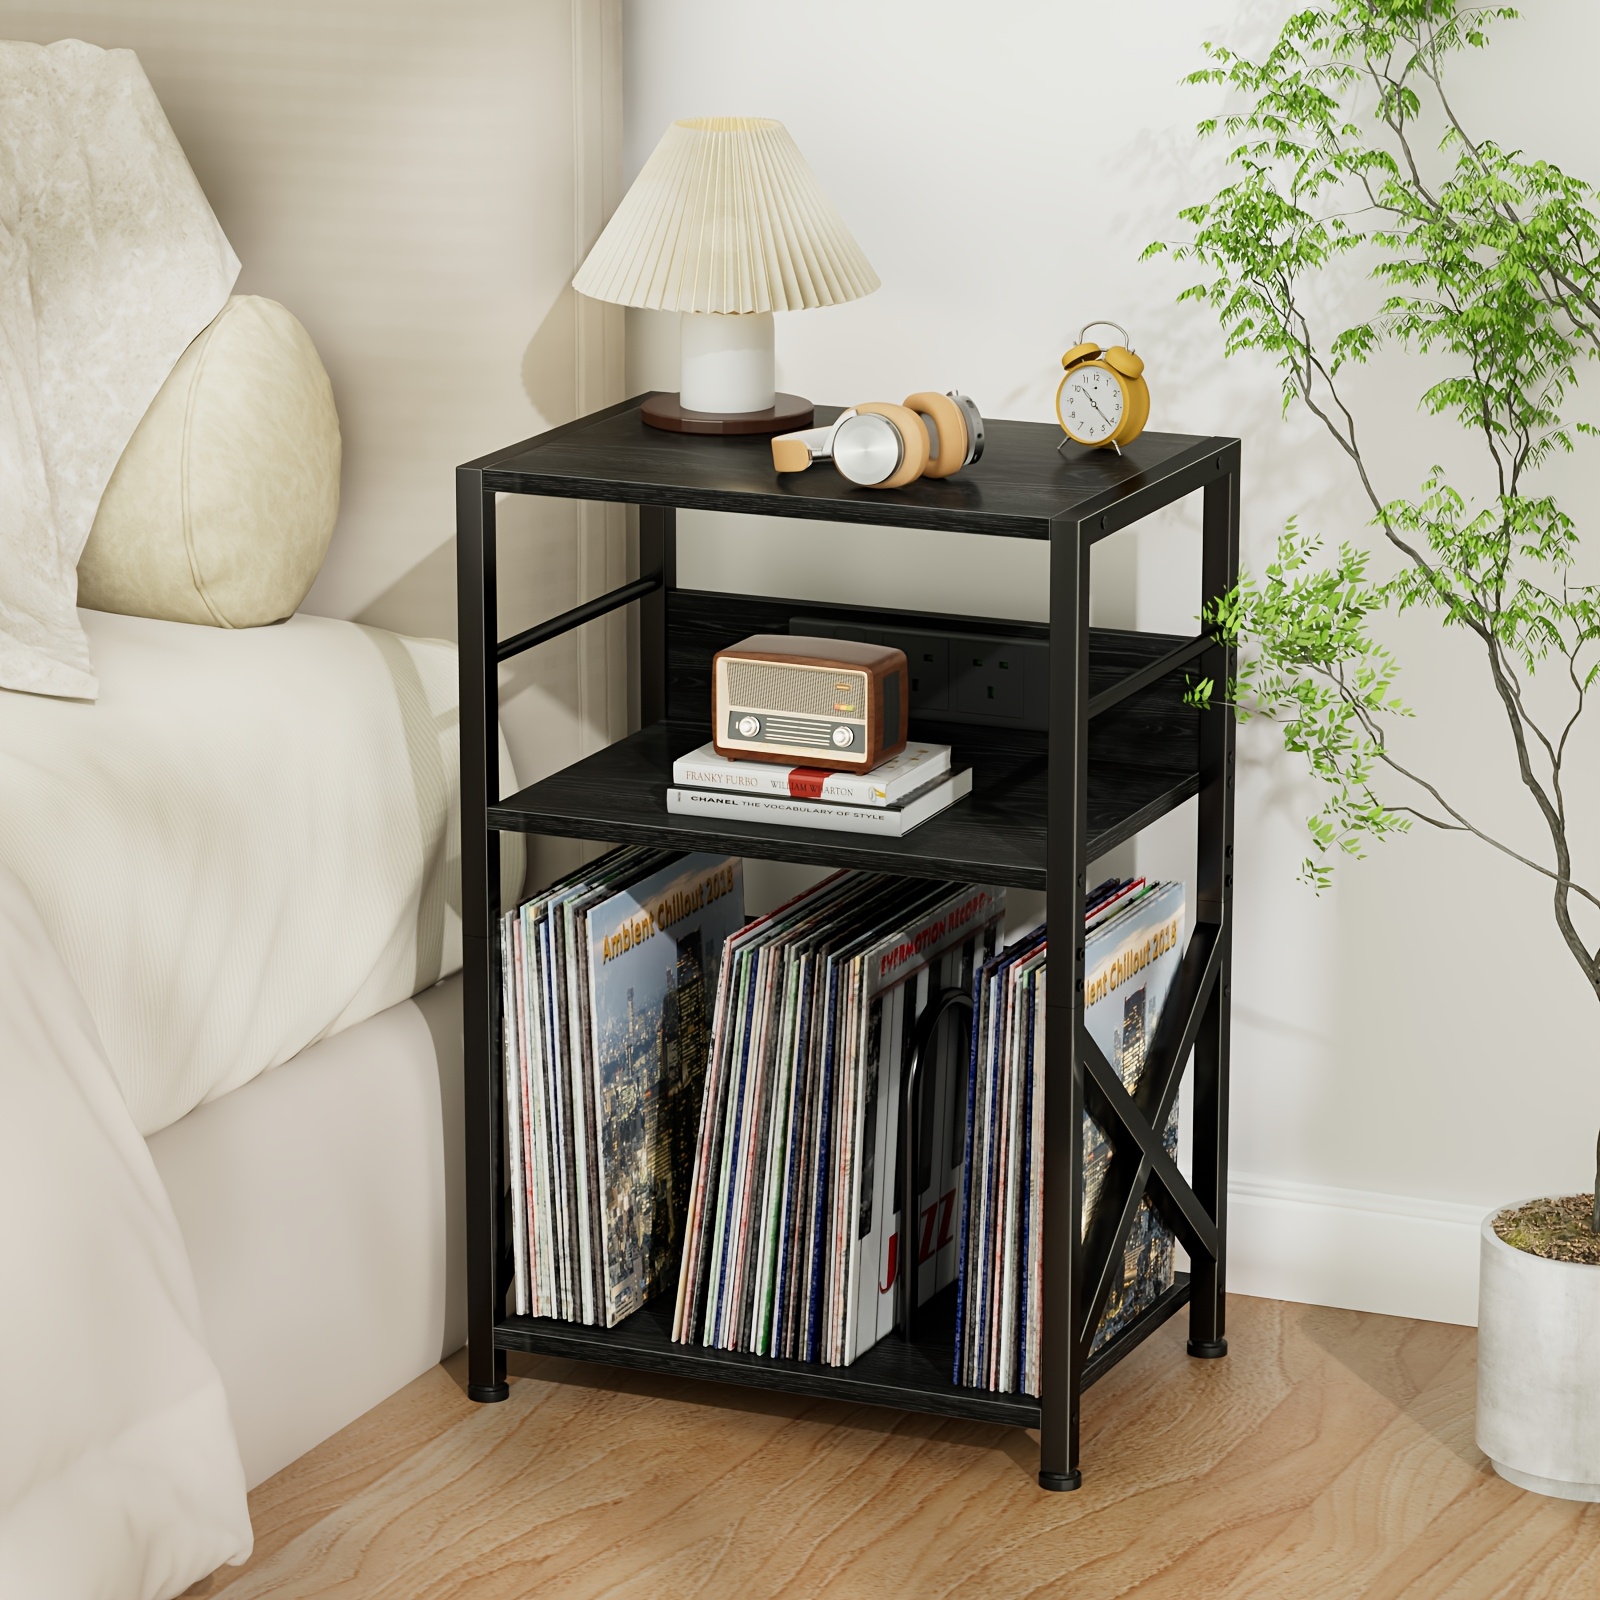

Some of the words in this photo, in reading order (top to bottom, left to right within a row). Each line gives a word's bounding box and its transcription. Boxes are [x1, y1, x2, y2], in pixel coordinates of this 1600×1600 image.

[685, 770, 724, 784] FRANKY
[726, 773, 758, 787] FURBO
[690, 795, 739, 806] CHANEL
[764, 803, 834, 815] VOCABULARY
[853, 812, 885, 820] STYLE
[770, 780, 807, 793] WILLIAM
[602, 911, 655, 965] Ambient
[657, 882, 704, 932] Chillout
[706, 865, 734, 906] 2018
[881, 917, 947, 977] EVERMOTION
[1109, 939, 1151, 991] Chillout
[1152, 919, 1177, 962] 2018
[879, 1187, 956, 1295] JZZ
